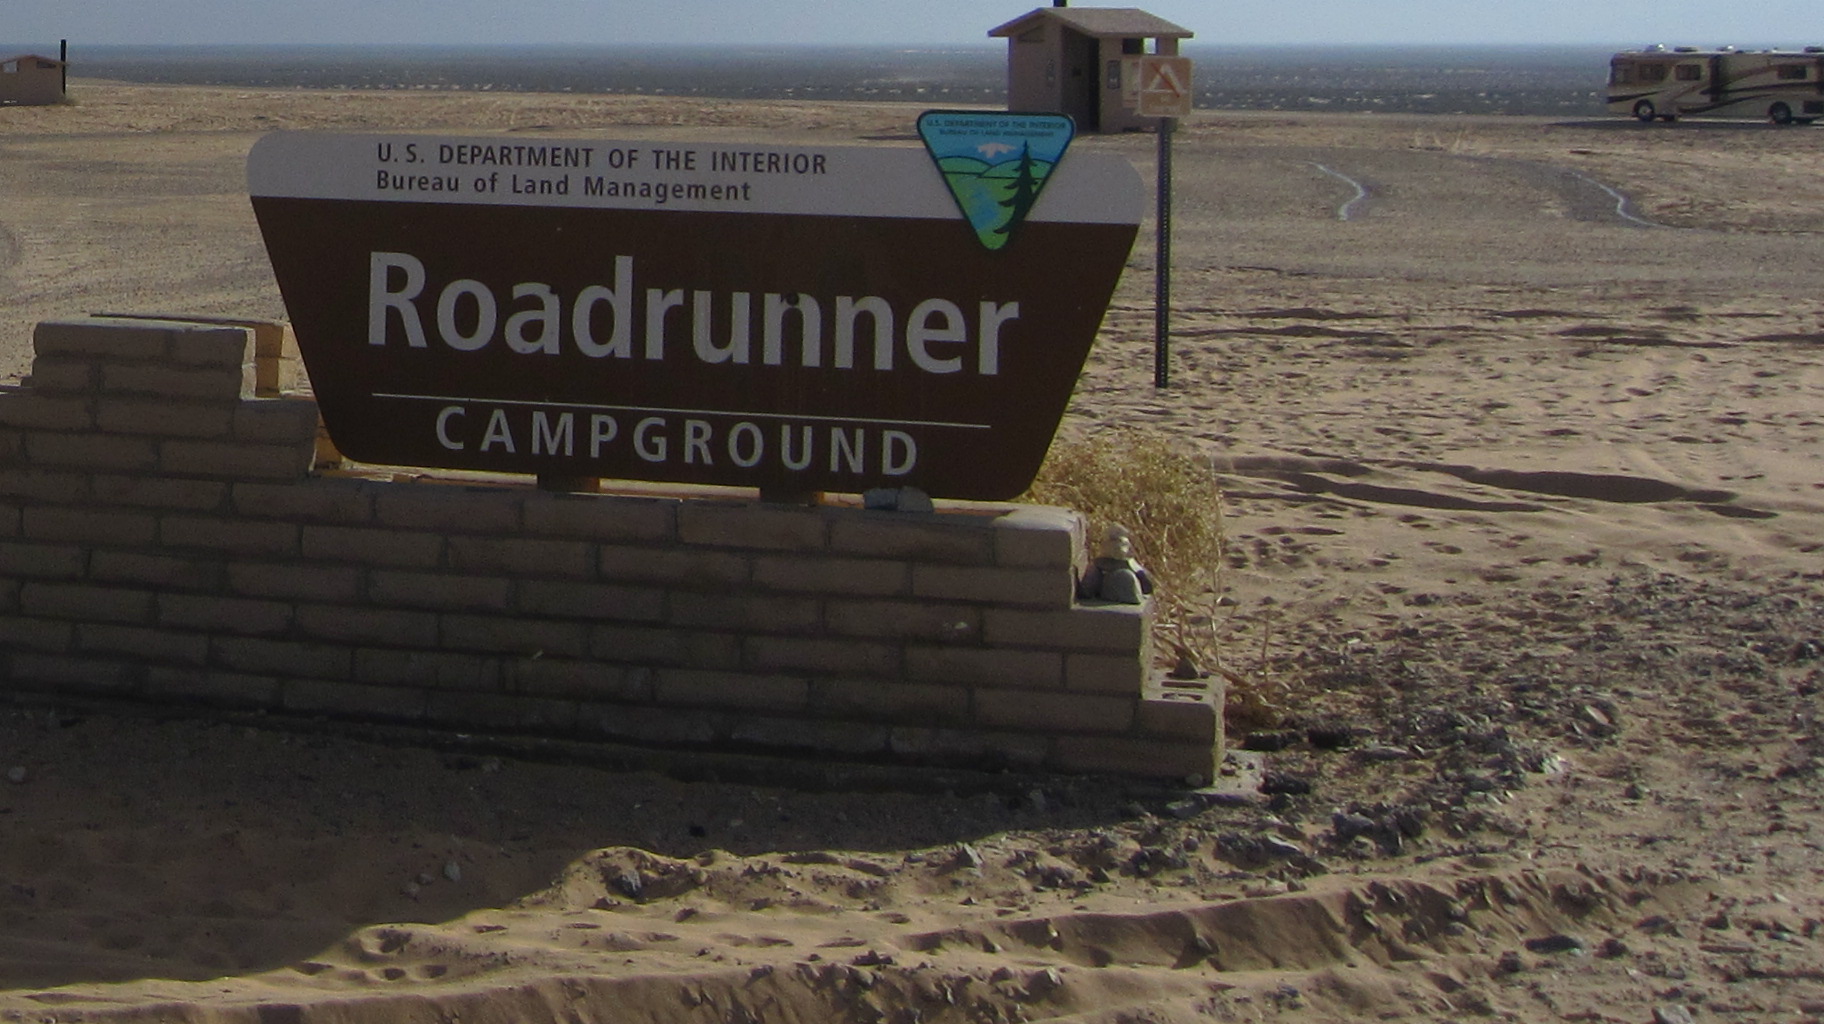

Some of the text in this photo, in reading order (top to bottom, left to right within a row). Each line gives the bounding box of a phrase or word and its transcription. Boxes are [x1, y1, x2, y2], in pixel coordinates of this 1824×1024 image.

[439, 144, 594, 168] DEPARTMENT
[608, 148, 639, 170] OF
[651, 149, 696, 171] THE
[711, 151, 827, 175] INTERIOR
[376, 169, 751, 205] Bureau of Land Management
[368, 251, 1020, 376] Roadrunner
[435, 405, 917, 476] CAMPGROUND
